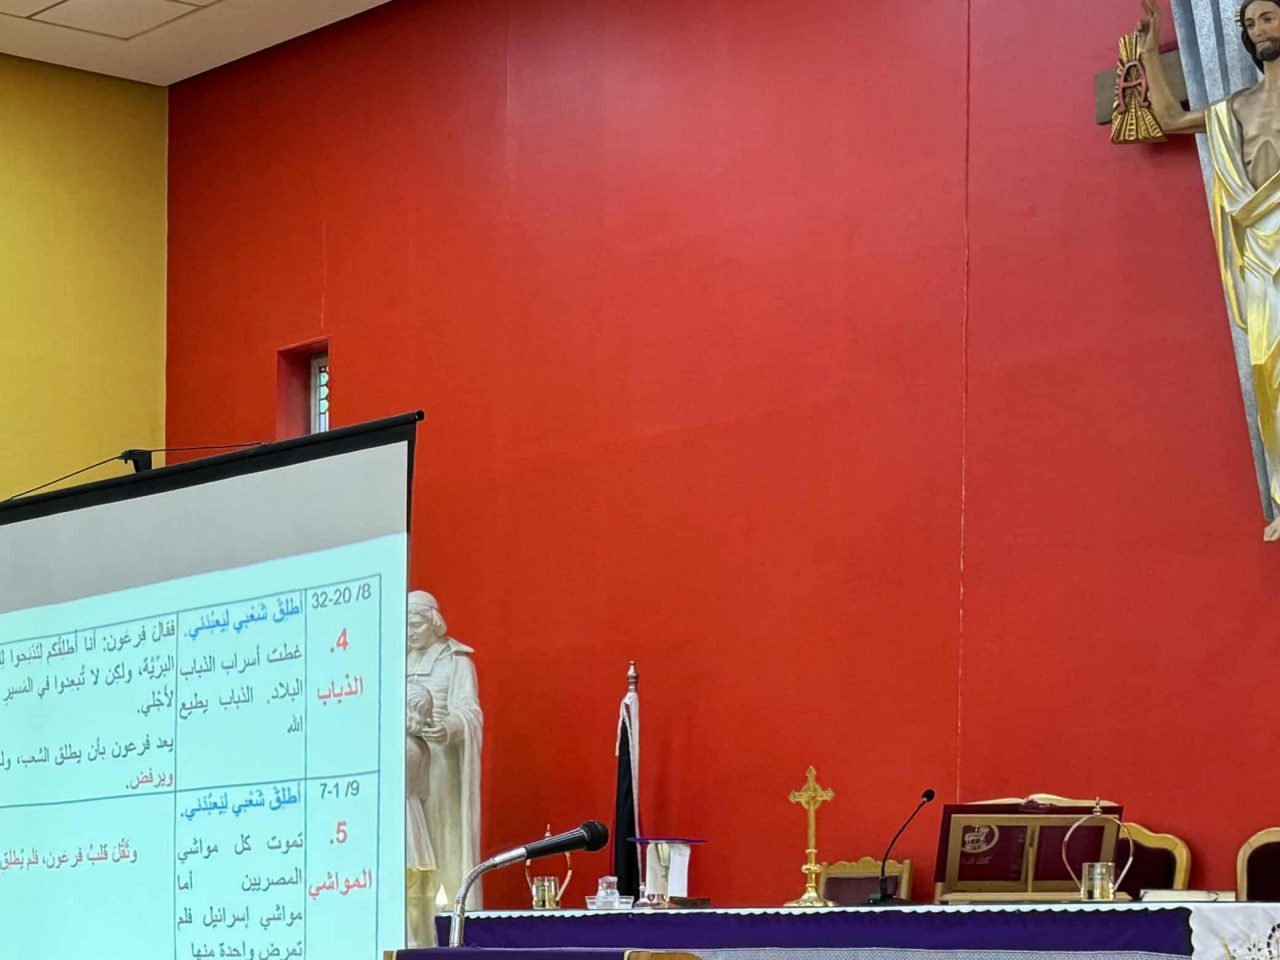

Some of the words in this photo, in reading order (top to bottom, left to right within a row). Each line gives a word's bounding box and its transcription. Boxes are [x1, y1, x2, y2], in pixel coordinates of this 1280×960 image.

[178, 653, 215, 680] الذباب
[220, 645, 260, 676] أسراب
[219, 685, 254, 710] الذباب
[316, 673, 365, 706] الذباب
[178, 692, 209, 720] يطيع
[287, 714, 304, 734] الله
[54, 743, 82, 766] يطلق
[88, 737, 106, 761] بأن
[111, 734, 151, 758] فرعون
[177, 837, 219, 865] مواشي
[234, 834, 252, 856] كل
[266, 831, 304, 855] تموت
[177, 869, 193, 891] أما
[241, 866, 303, 893] المصريين
[308, 868, 374, 900] المواشي
[177, 906, 193, 933] فلم
[259, 903, 303, 930] مواشي
